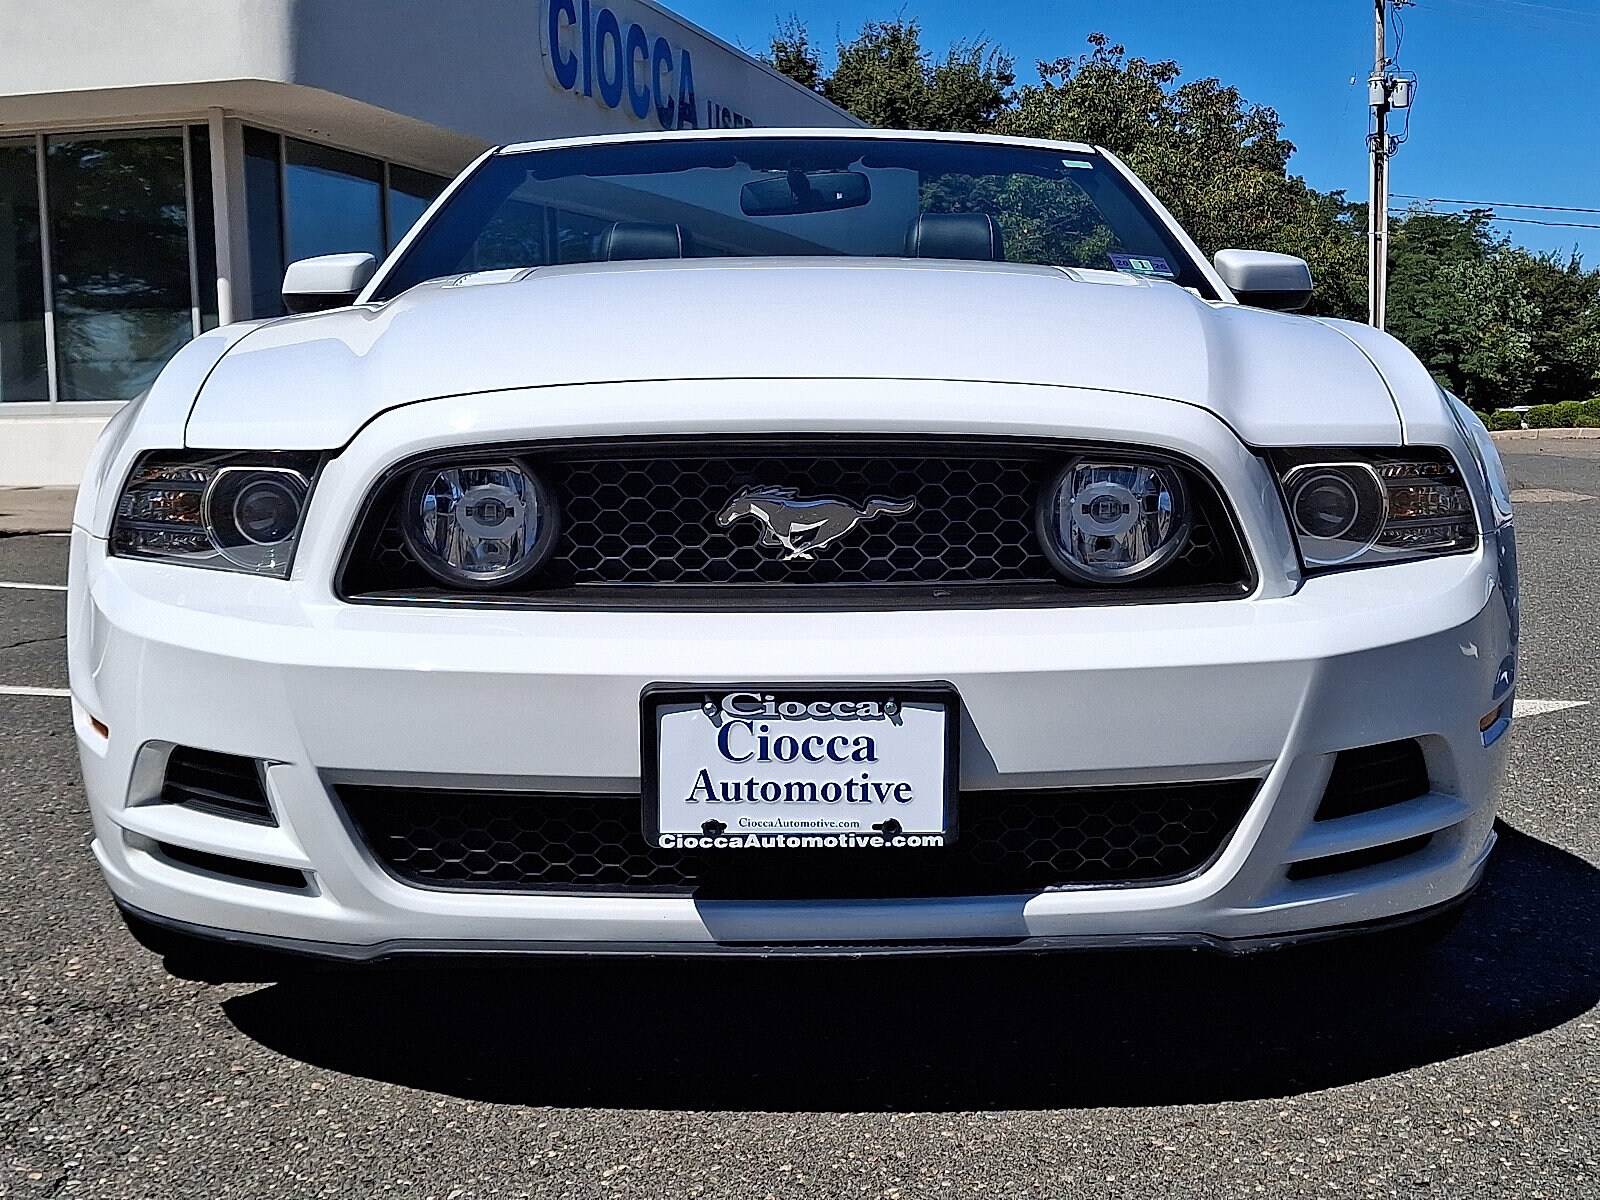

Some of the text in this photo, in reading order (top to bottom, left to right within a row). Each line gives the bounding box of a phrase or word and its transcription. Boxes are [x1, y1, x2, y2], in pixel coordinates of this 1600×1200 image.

[549, 0, 698, 130] CIOCCA
[721, 693, 884, 719] Ciocca
[717, 719, 878, 762] Ciocca
[685, 769, 913, 803] Automotive
[738, 817, 861, 829] CioccaAutomotive.com
[658, 834, 944, 848] CioccaAutomotive.com
